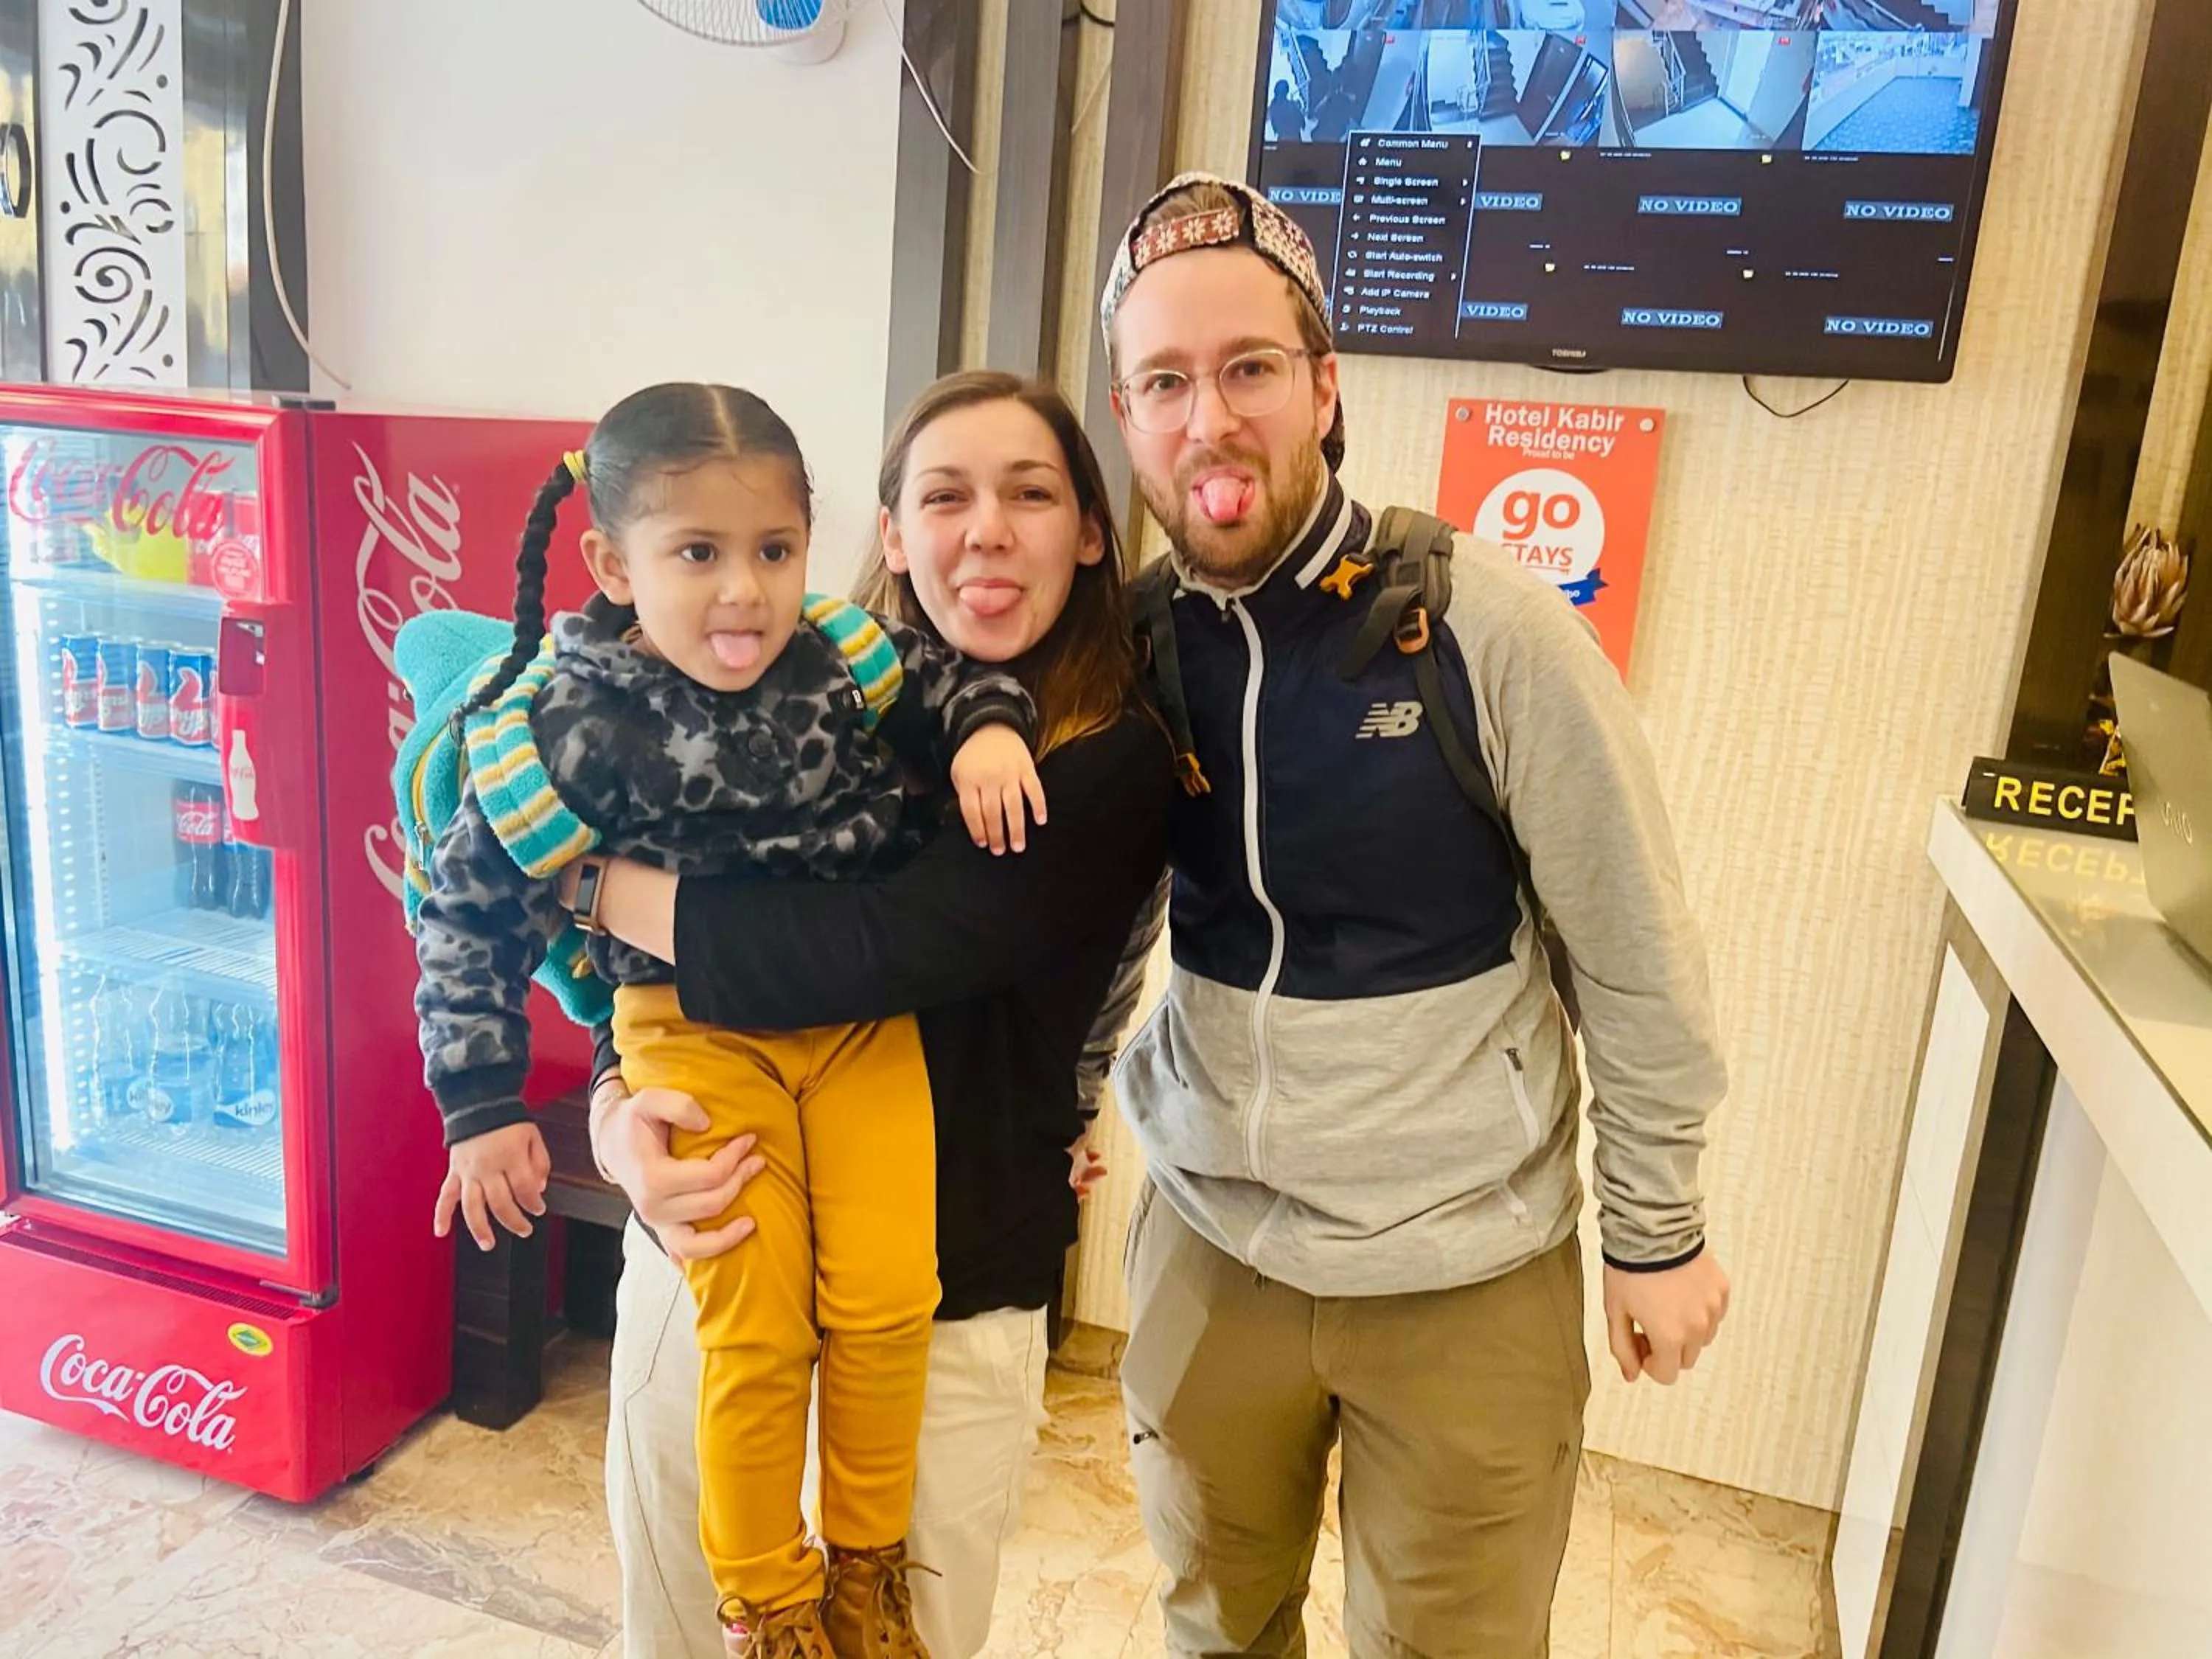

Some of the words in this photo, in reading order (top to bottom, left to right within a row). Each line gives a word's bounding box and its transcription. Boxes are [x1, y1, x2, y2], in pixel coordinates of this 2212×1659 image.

[1378, 138, 1419, 147] Common
[1421, 139, 1449, 149] Menu
[1375, 157, 1402, 167] Menu
[1374, 176, 1402, 187] Single
[1405, 177, 1439, 187] Screen
[1270, 189, 1294, 201] NO
[1481, 195, 1540, 209] VIDEO
[1639, 199, 1669, 212] NO
[1674, 200, 1738, 214] VIDEO
[1845, 205, 1876, 218] NO
[1884, 206, 1951, 220] VIDEO
[1369, 214, 1410, 224] Previous
[1412, 215, 1446, 225] Screen
[1367, 232, 1388, 242] Next
[1390, 233, 1424, 243] Screen
[1365, 251, 1387, 260] Start
[1363, 268, 1385, 278] Start
[1387, 269, 1435, 282] Recording
[1361, 288, 1380, 296] Add
[1393, 288, 1430, 299] Camera
[1359, 305, 1402, 316] Playback
[1467, 305, 1525, 318] VIDEO
[1622, 311, 1651, 324] NO
[1658, 313, 1721, 327] VIDEO
[1826, 319, 1856, 332] NO
[1863, 320, 1930, 335] VIDEO
[1485, 403, 1551, 428] Hotel
[1557, 407, 1626, 432] Kabir
[1488, 424, 1615, 459] Residency
[1502, 490, 1581, 541] go
[1501, 543, 1573, 566] TAYS
[40, 1334, 248, 1451] Coca-Cola
